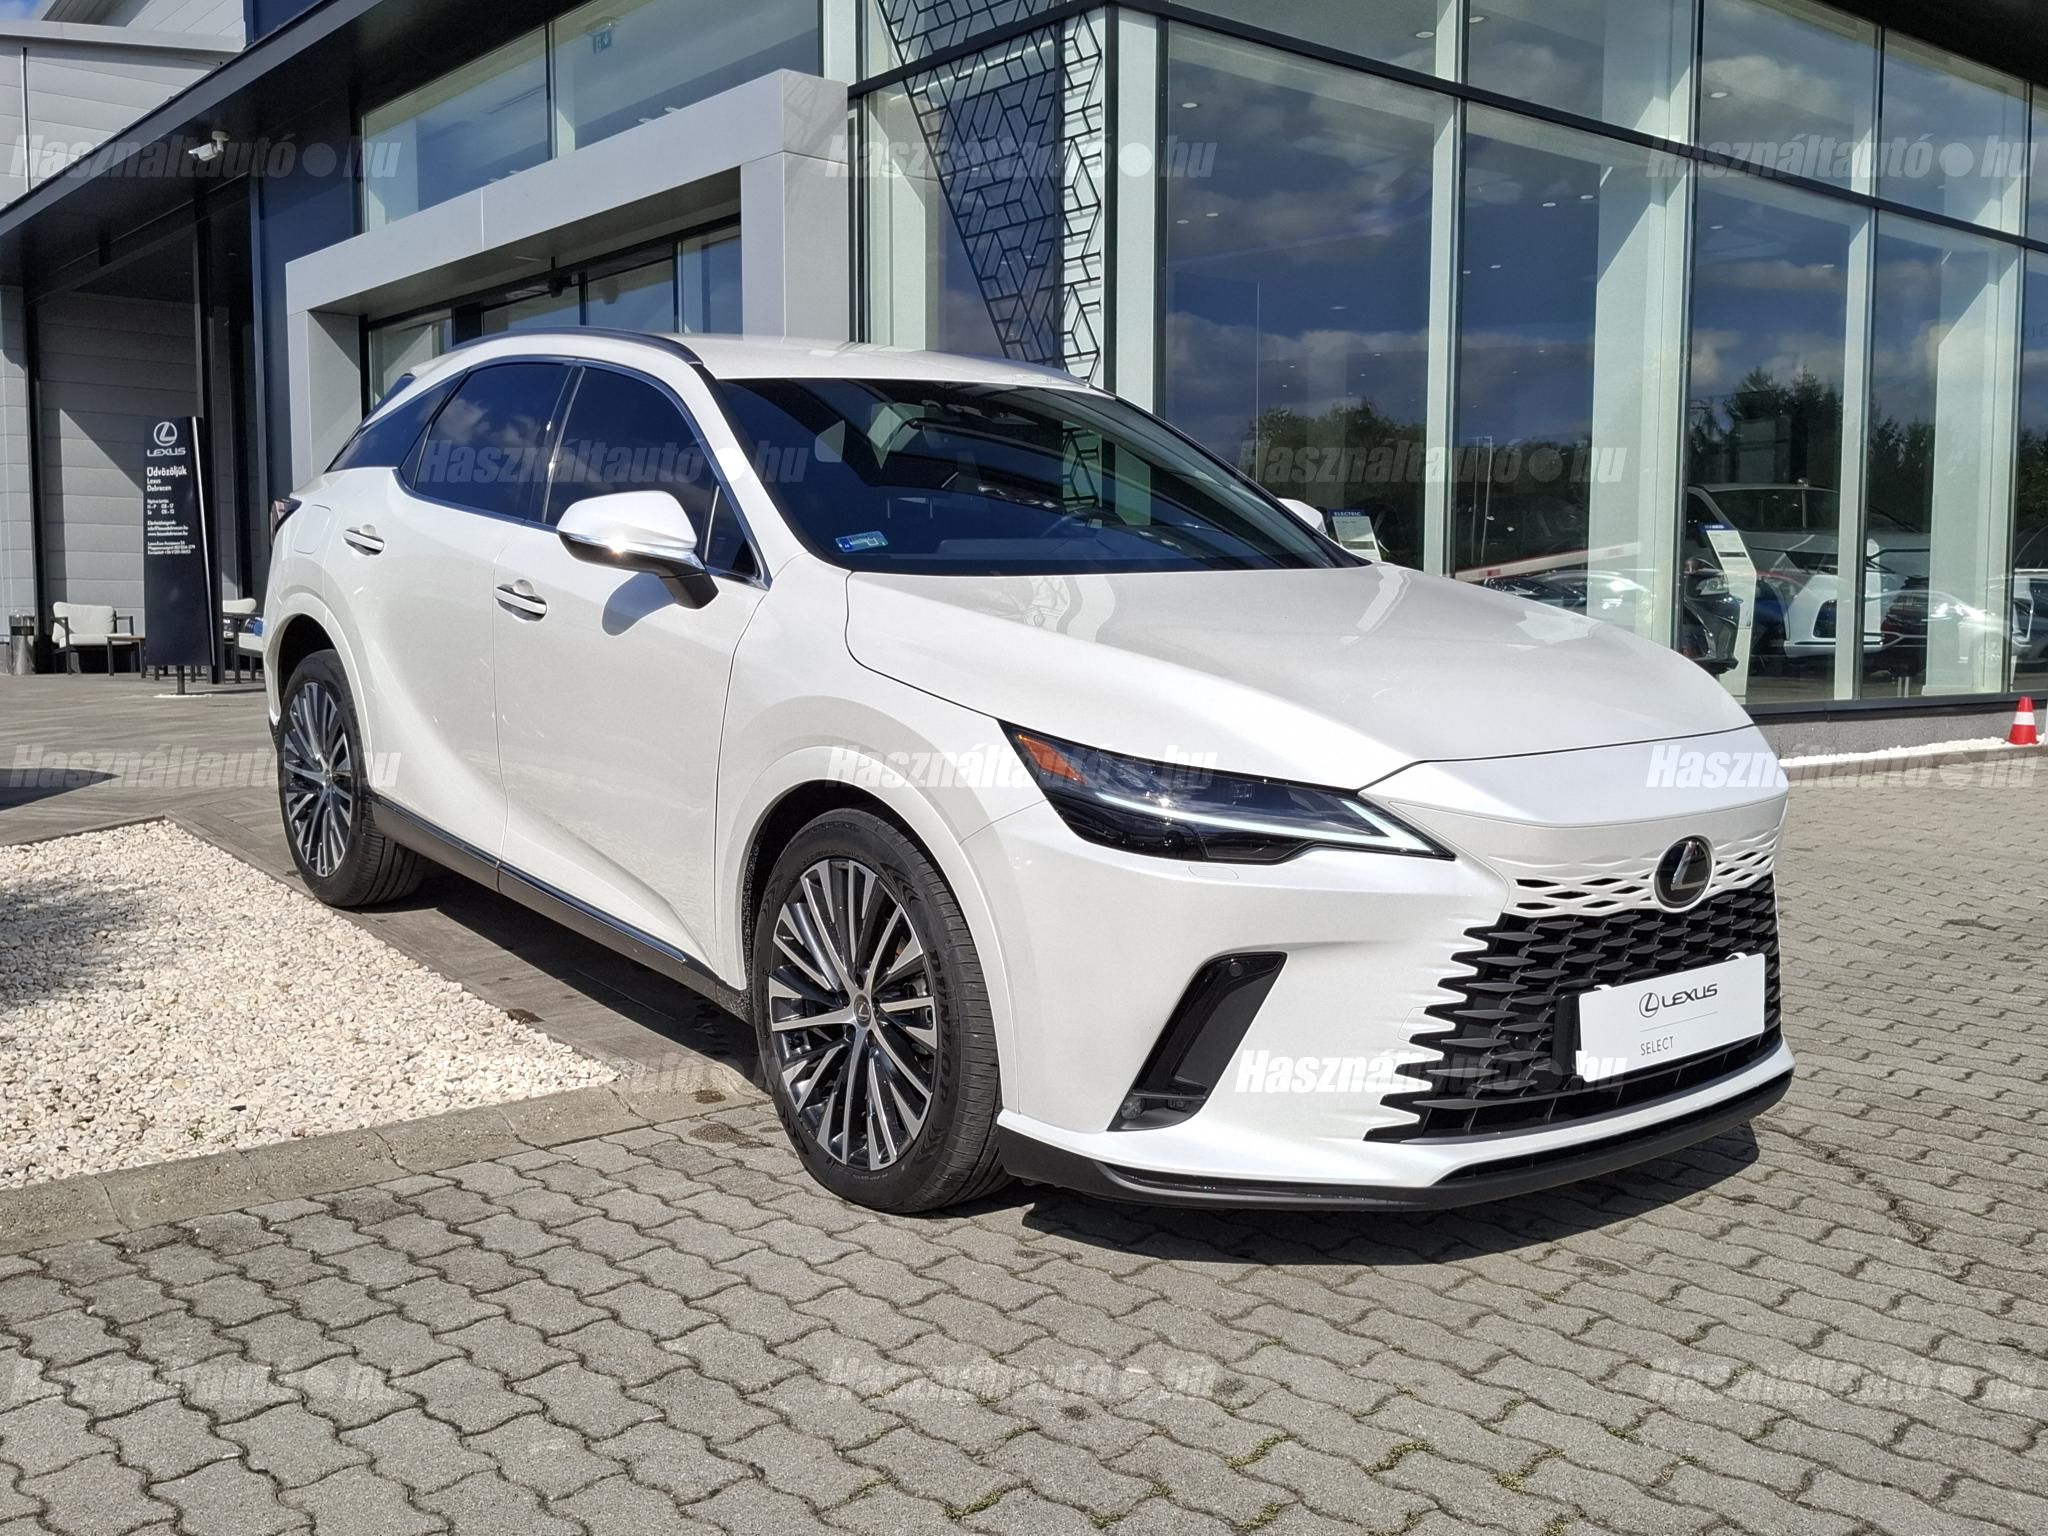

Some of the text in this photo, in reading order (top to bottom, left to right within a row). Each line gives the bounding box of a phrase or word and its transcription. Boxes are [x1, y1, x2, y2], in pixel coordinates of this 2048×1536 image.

[146, 447, 186, 457] LEXUS
[1661, 983, 1718, 1008] LEXUS
[1640, 1035, 1674, 1056] SELECT
